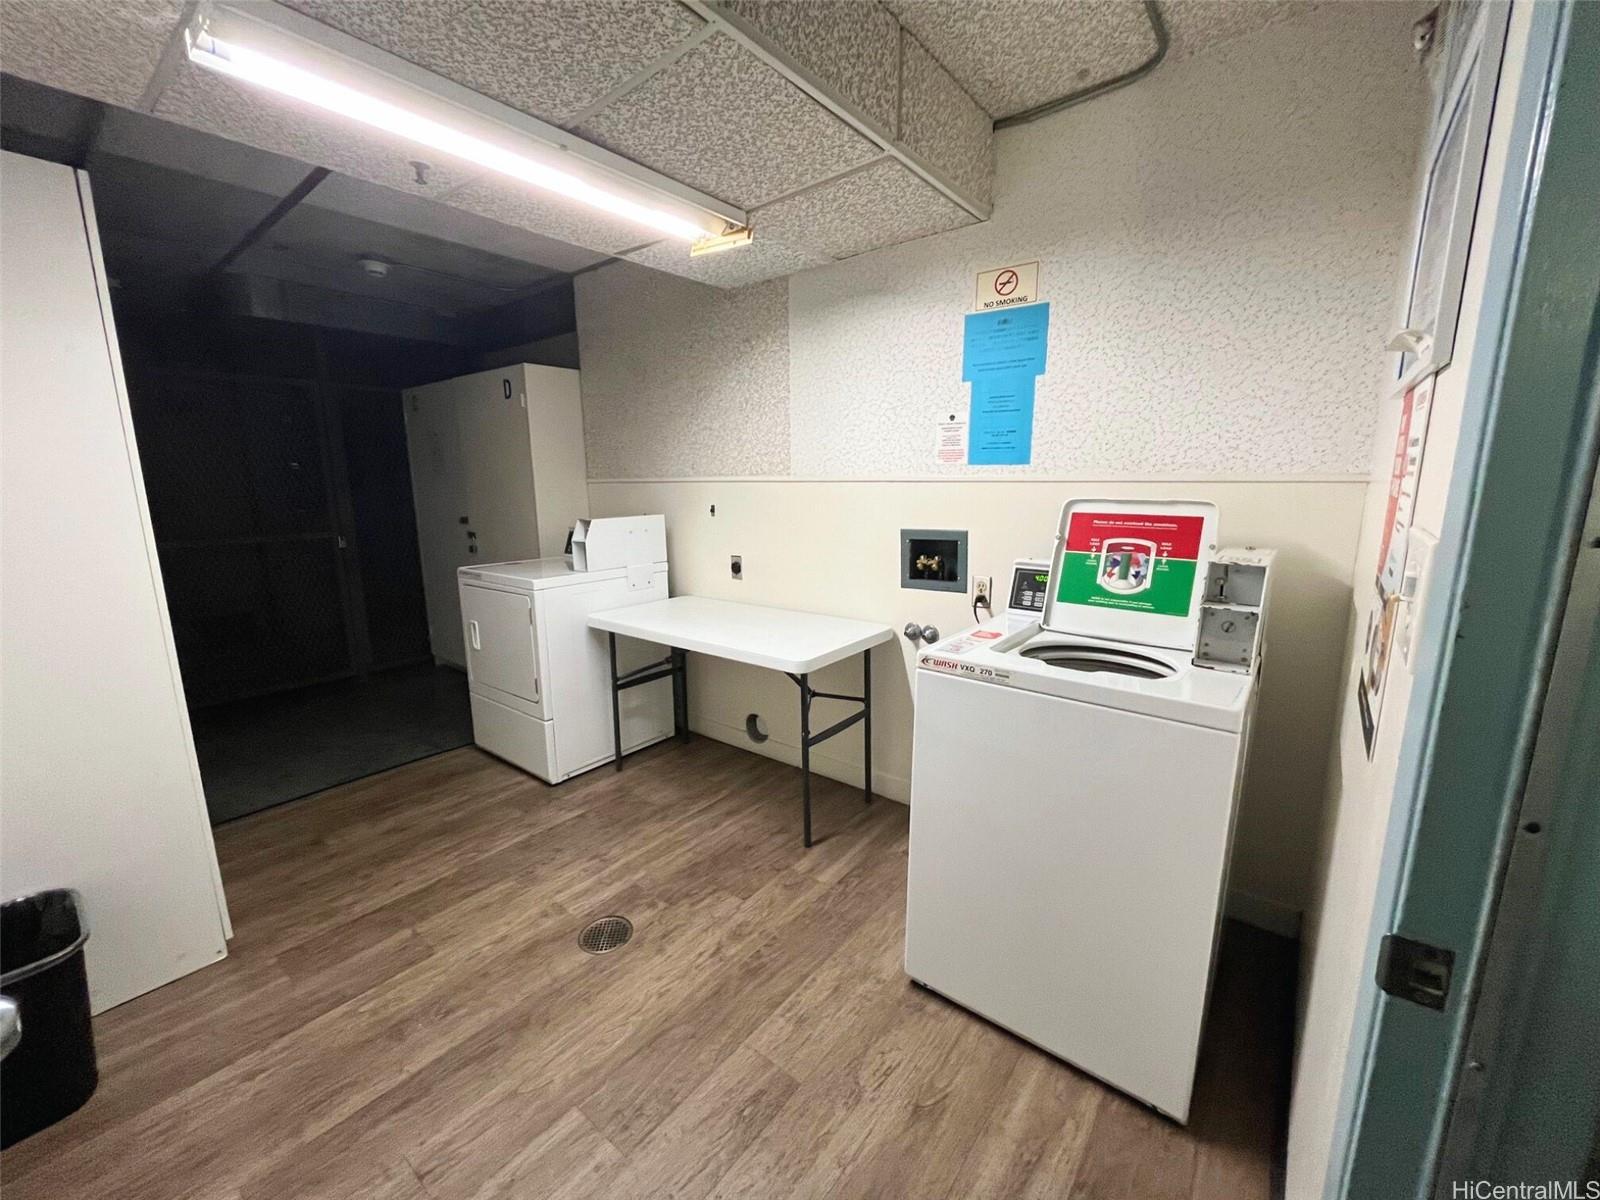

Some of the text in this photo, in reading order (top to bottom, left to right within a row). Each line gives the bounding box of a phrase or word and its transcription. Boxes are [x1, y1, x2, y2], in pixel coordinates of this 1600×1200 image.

[996, 296, 1028, 305] SMOKING
[503, 379, 512, 399] D
[933, 659, 958, 670] WASH
[980, 668, 993, 677] 270
